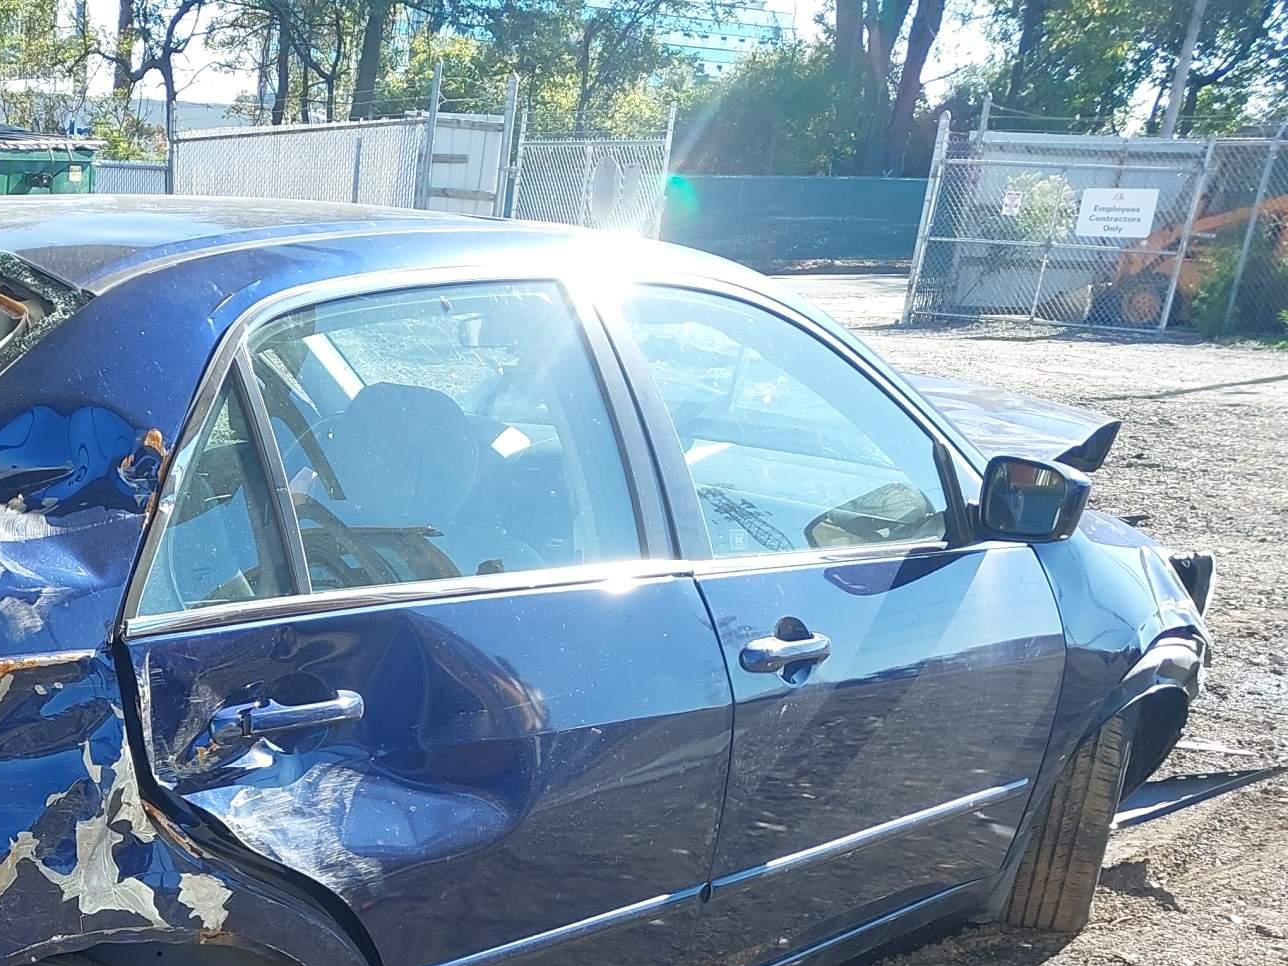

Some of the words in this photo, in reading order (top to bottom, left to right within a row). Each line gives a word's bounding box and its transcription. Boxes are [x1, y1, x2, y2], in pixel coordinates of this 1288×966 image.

[1093, 204, 1141, 214] Employees
[1088, 214, 1142, 223] Contractors
[1102, 224, 1124, 234] Only
